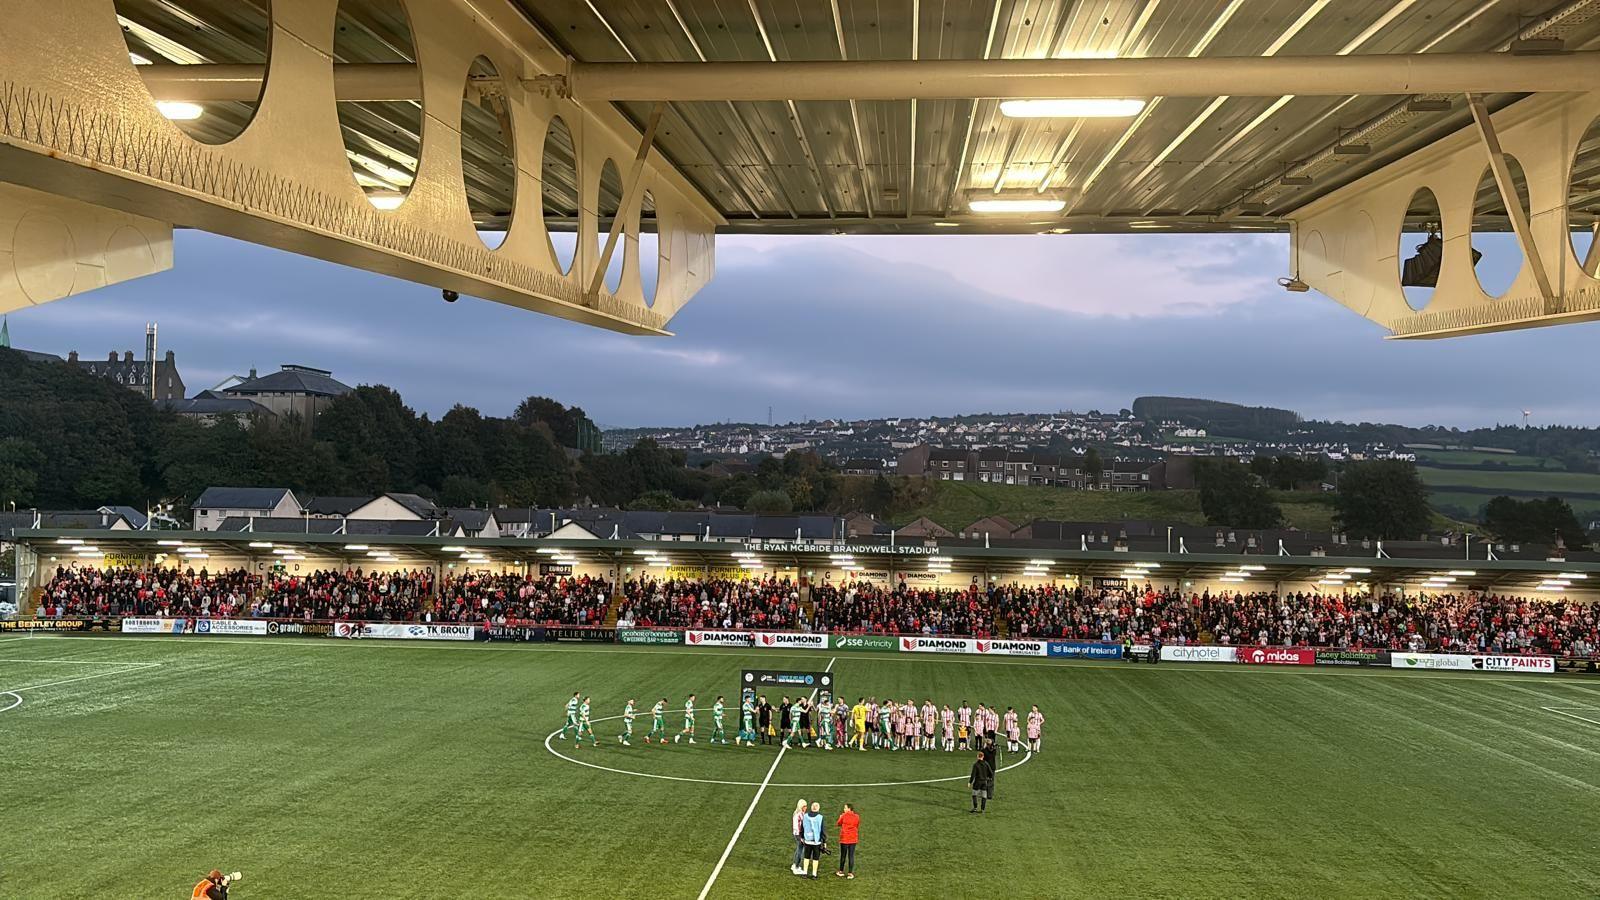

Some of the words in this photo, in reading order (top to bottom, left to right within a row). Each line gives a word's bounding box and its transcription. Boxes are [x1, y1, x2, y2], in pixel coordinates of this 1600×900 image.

[833, 545, 896, 553] BRANDYWELL
[899, 546, 939, 554] STADIUM
[18, 620, 54, 628] BENTLEY
[55, 620, 83, 628] GROUP
[440, 626, 470, 634] BROLLY
[545, 630, 585, 638] ATELIER
[590, 630, 614, 638] HAIR
[703, 633, 750, 642] DIAMOND
[776, 635, 822, 644] DIAMOND
[847, 638, 863, 646] sse
[864, 639, 893, 649] Airtricity
[918, 639, 967, 649] DIAMOND
[991, 642, 1041, 651] DIAMOND
[1090, 647, 1117, 655] Ireland
[1172, 647, 1220, 659] cityhotel
[1266, 650, 1300, 661] midas
[1316, 651, 1340, 659] Lacey
[1435, 658, 1459, 667] global
[1485, 657, 1510, 667] CITY
[1511, 657, 1552, 668] PAINTS
